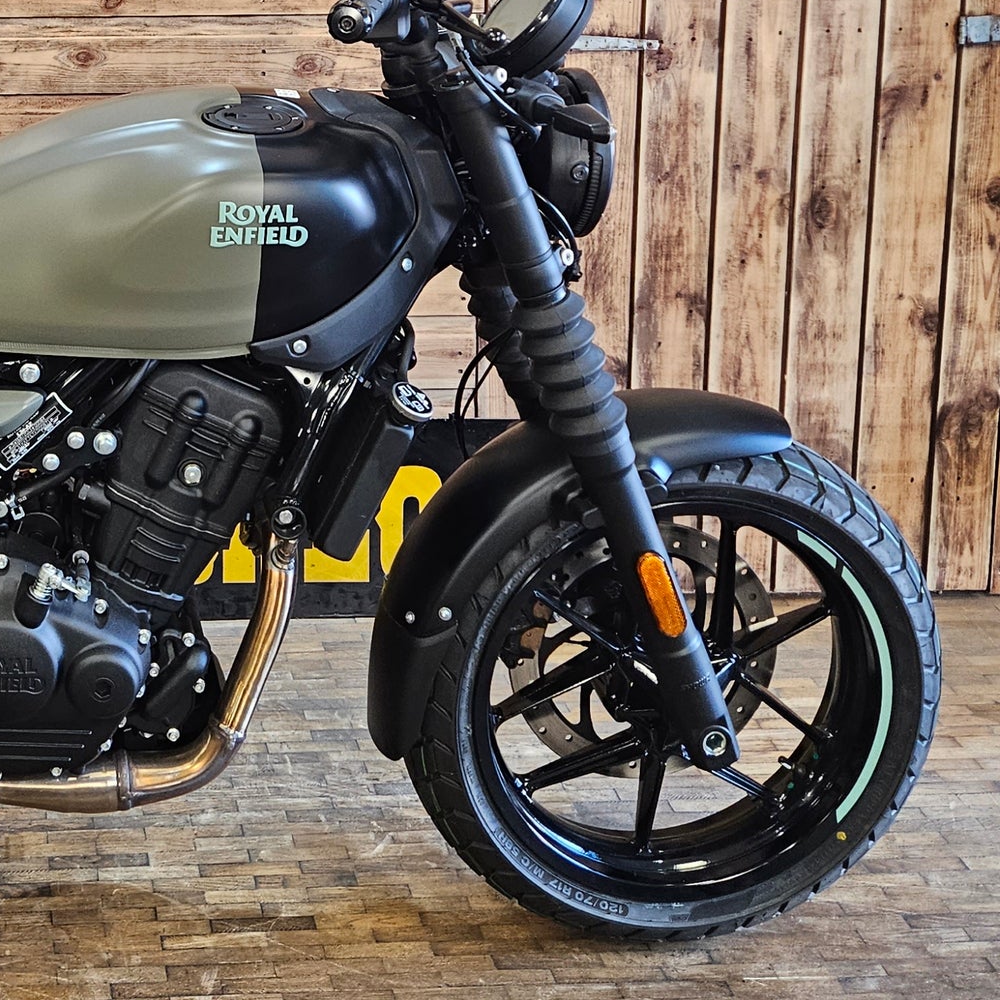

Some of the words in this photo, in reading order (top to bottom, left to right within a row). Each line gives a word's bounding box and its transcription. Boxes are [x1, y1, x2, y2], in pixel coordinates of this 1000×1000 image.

[218, 201, 299, 226] ROYAL
[209, 225, 309, 248] ENFIELD
[574, 889, 629, 917] 120/70
